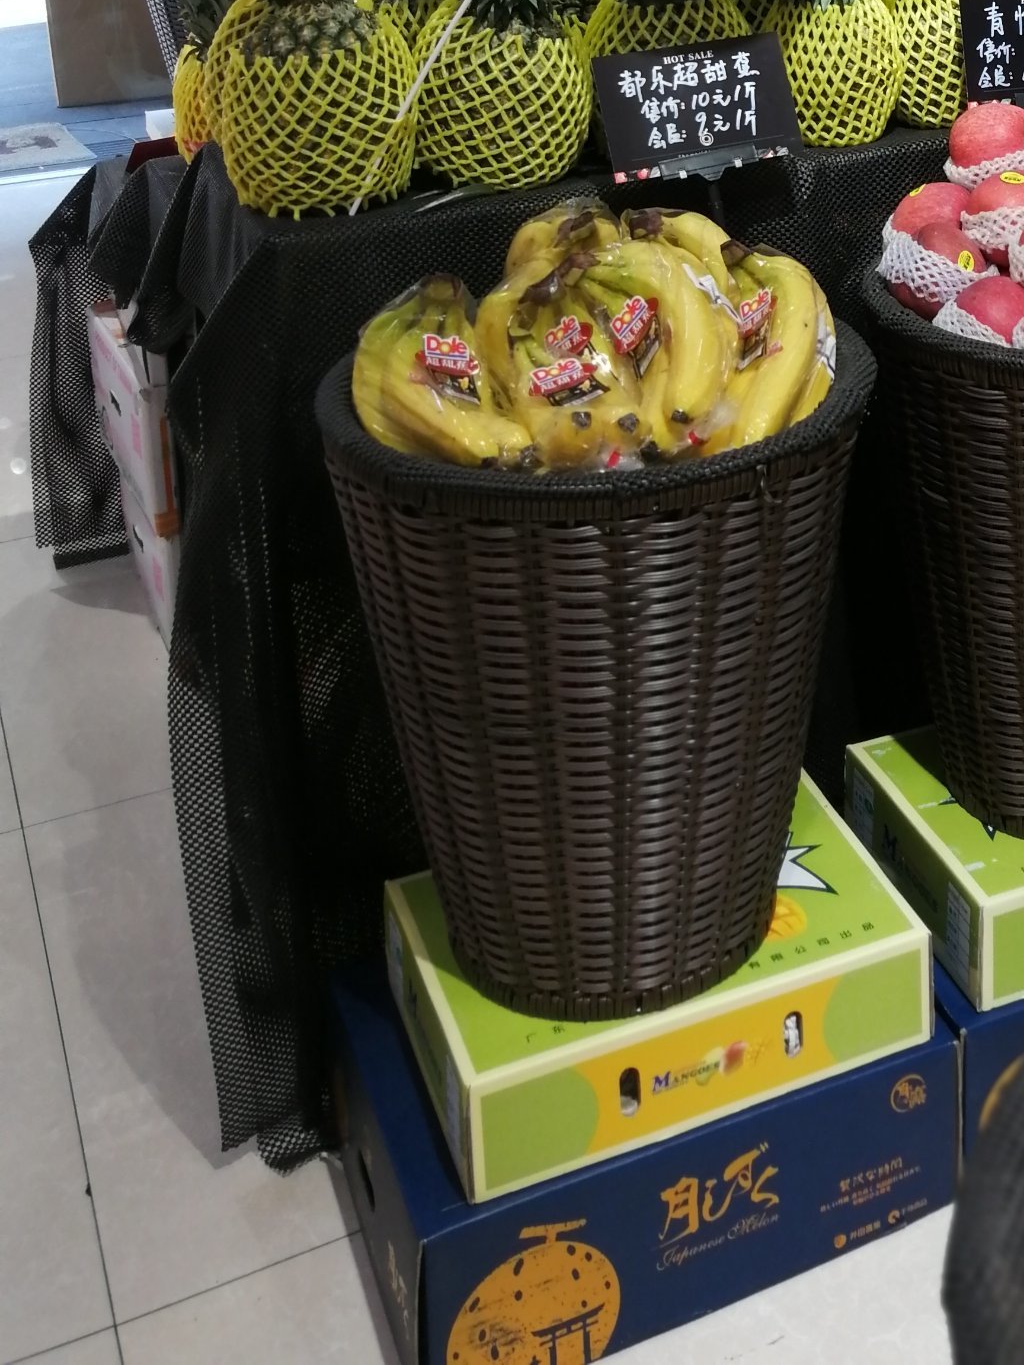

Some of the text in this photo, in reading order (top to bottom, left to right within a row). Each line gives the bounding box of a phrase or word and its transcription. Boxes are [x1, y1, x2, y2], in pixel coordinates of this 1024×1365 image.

[663, 50, 714, 65] HOT SALE
[618, 52, 760, 103] 都乐超甜蕉
[612, 298, 642, 335] Dole
[741, 289, 769, 317] Dole
[427, 335, 467, 354] Dole
[545, 317, 577, 345] Dole
[531, 360, 577, 382] Dole
